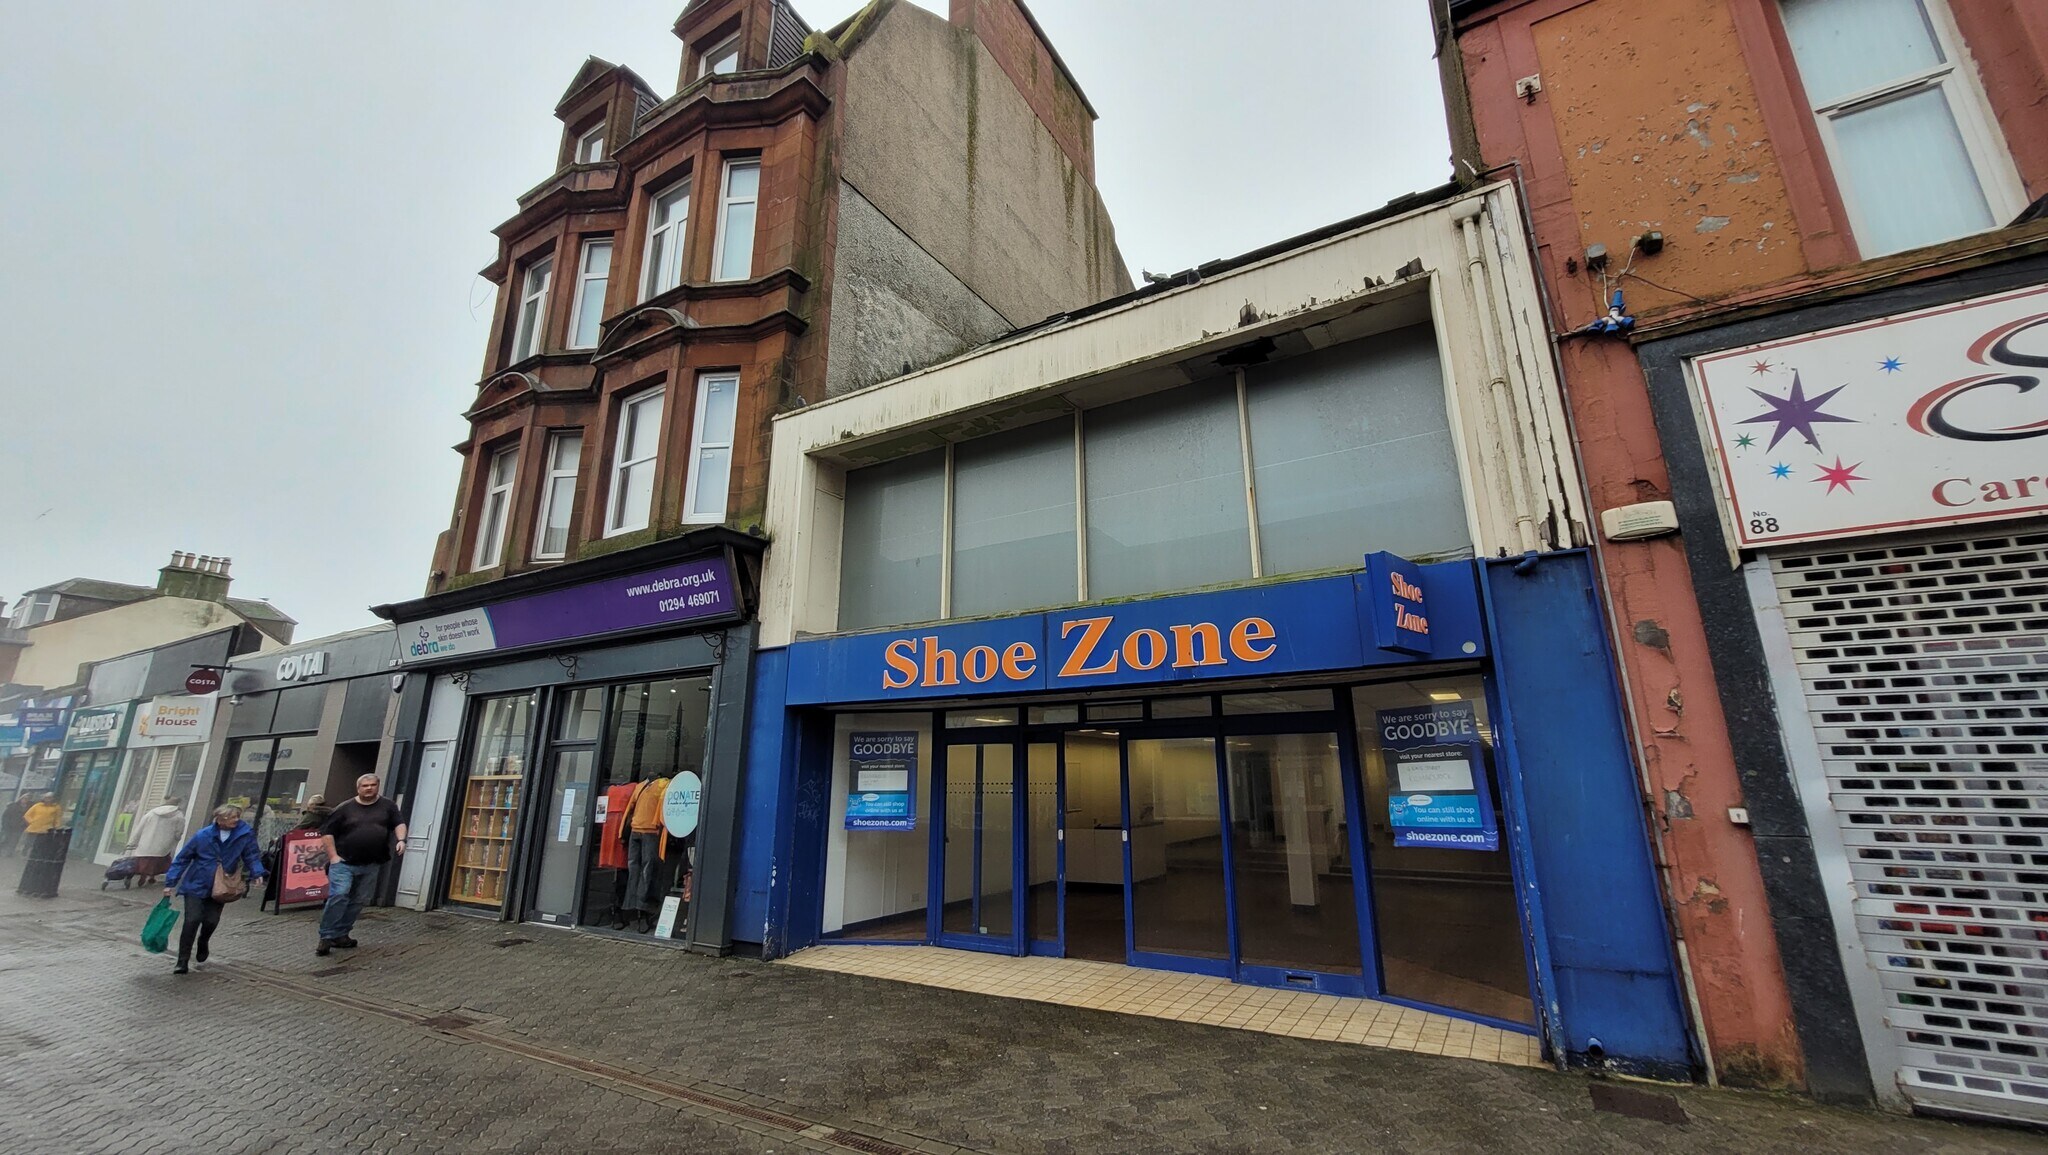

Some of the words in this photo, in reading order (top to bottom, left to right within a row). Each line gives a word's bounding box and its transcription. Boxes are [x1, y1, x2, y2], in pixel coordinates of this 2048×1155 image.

[1931, 475, 2048, 508] Car
[1752, 510, 1772, 518] No.
[1749, 517, 1780, 534] 88
[626, 568, 716, 597] www.debra.org.uk
[1390, 571, 1423, 603] Shoe
[659, 597, 685, 612] 01294
[688, 590, 720, 607] 469071
[443, 621, 460, 632] people
[461, 618, 478, 627] whose
[1394, 602, 1429, 634] Zone
[437, 634, 448, 642] skin
[449, 630, 467, 640] doesn't
[467, 628, 480, 637] work
[410, 640, 439, 656] debra
[882, 635, 1037, 690] Shoe
[1057, 615, 1277, 677] Zone
[276, 651, 327, 681] COSTA
[189, 678, 216, 686] COSTA
[158, 706, 200, 717] Bright
[1382, 715, 1397, 723] We
[1398, 715, 1412, 723] are
[1414, 712, 1438, 722] sorry
[1439, 710, 1450, 718] to
[1451, 709, 1468, 718] say
[155, 717, 198, 727] House
[1384, 719, 1472, 740] GOODBYE
[853, 743, 914, 754] GOODBYE
[667, 790, 701, 800] DONATE
[1456, 806, 1475, 815] shop
[853, 818, 907, 826] shoezone.com
[1406, 831, 1485, 843] shoezone.com
